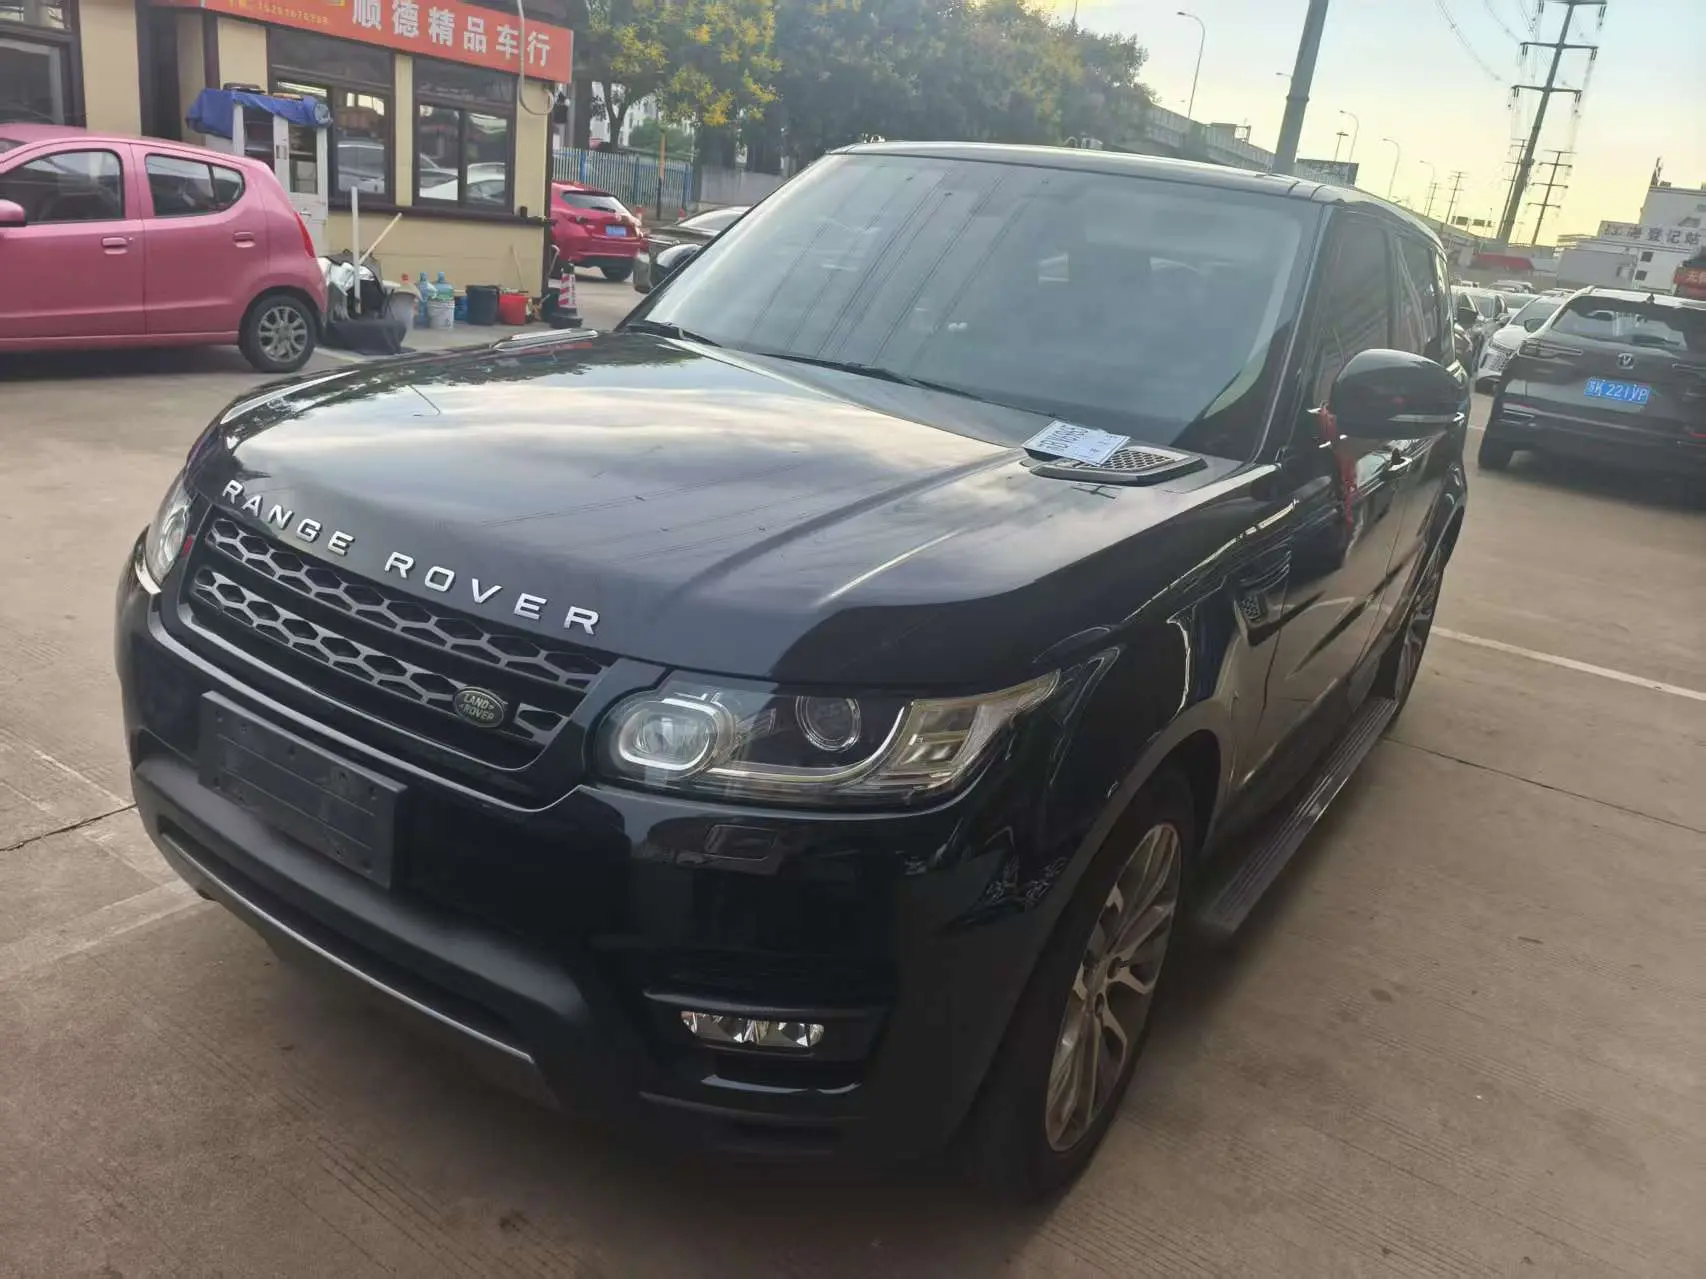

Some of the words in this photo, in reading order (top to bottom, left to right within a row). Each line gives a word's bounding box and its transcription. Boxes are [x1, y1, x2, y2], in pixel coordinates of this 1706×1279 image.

[352, 0, 551, 67] 顺德精品车行
[222, 479, 354, 556] RANGE
[384, 551, 599, 634] ROVER
